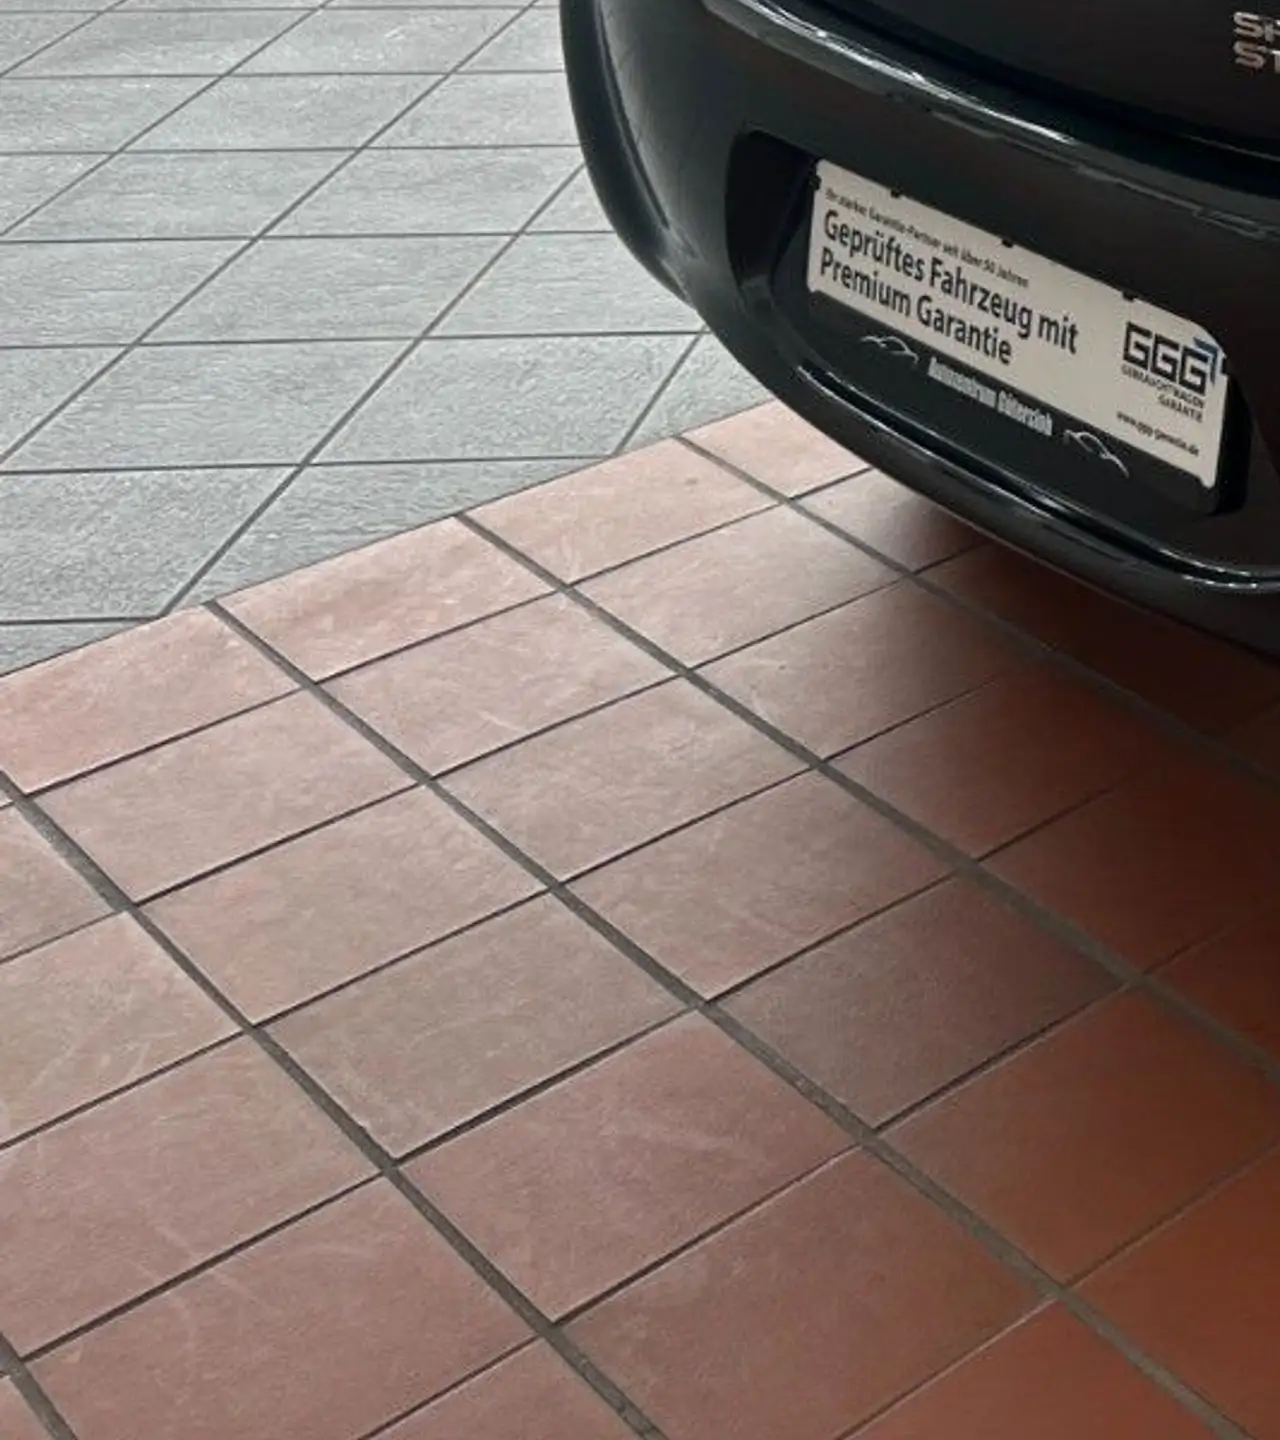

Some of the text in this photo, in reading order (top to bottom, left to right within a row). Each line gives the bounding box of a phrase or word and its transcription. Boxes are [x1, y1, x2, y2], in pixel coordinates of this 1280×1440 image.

[820, 246, 1013, 365] Premium Garantie
[824, 209, 1079, 355] Geprüftes Fahrzeug mit
[1123, 320, 1208, 397] GGG
